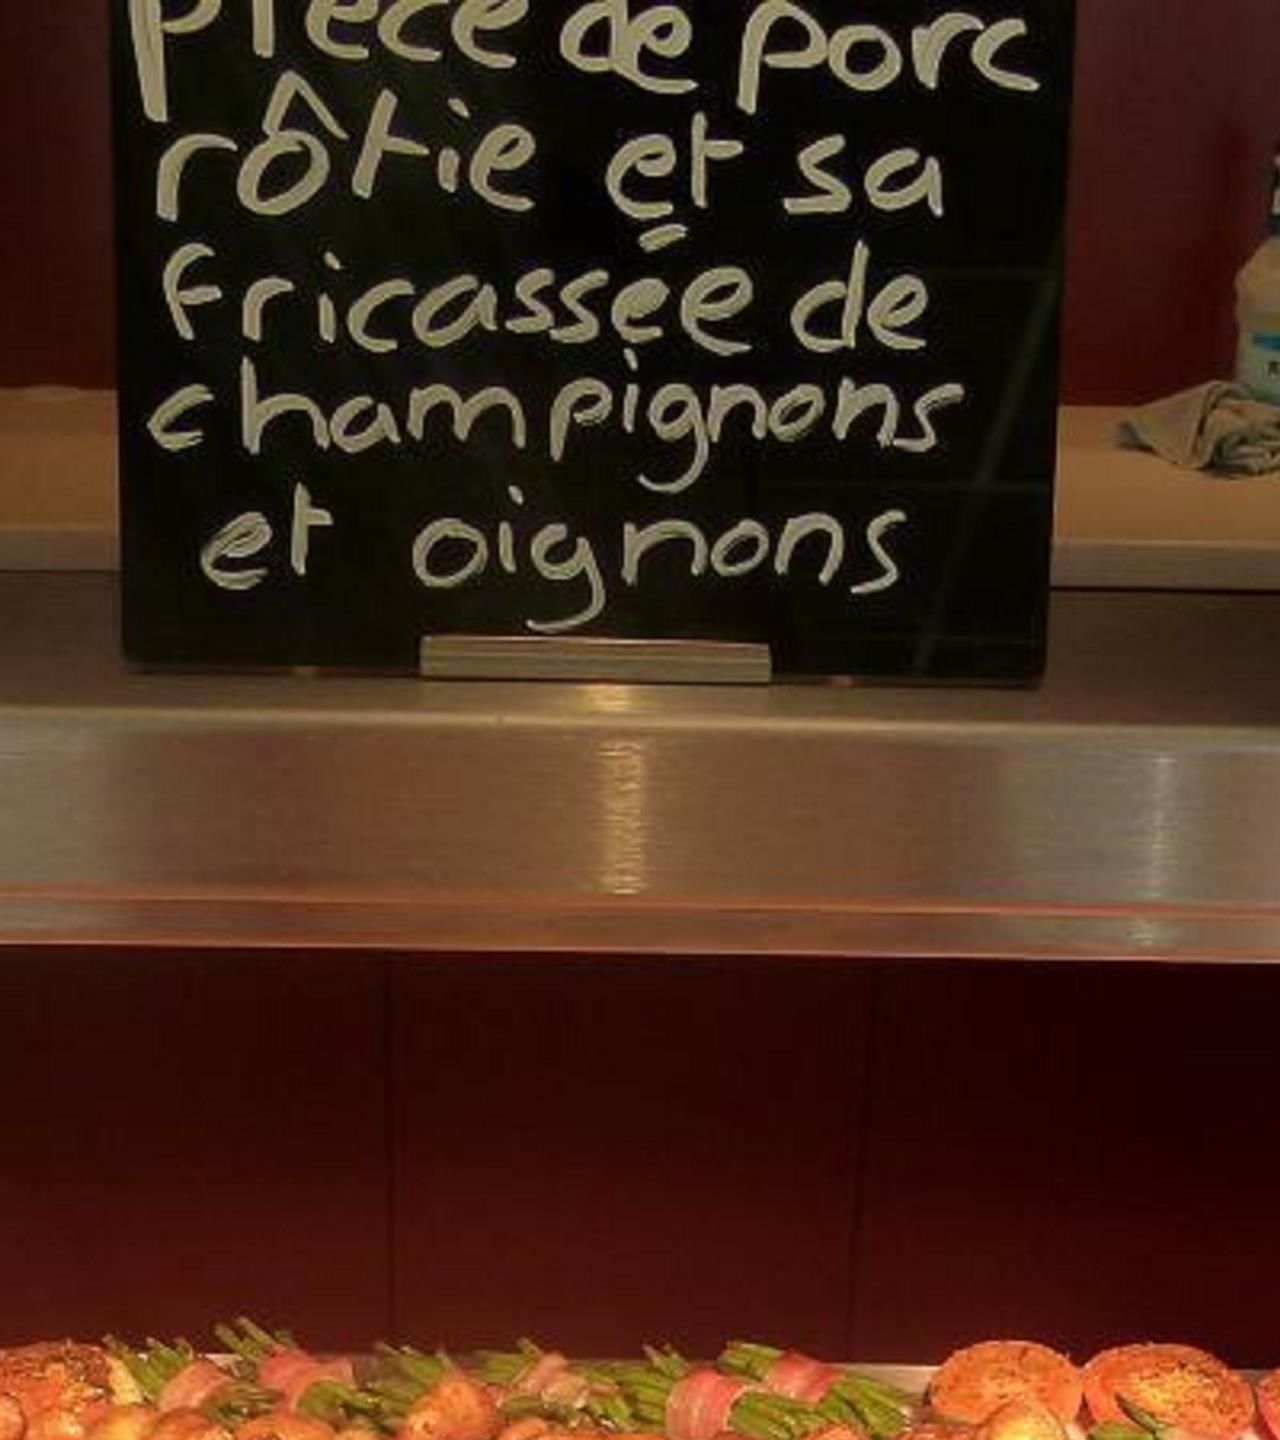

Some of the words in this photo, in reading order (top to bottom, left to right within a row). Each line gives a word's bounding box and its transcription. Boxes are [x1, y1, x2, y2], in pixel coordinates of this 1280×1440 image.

[560, 0, 698, 94] de
[155, 70, 538, 222] rôtie
[606, 112, 744, 218] et
[783, 133, 943, 217] sa
[789, 240, 930, 349] de
[146, 347, 964, 494] champignons
[200, 482, 334, 589] et
[410, 485, 909, 631] oignons
